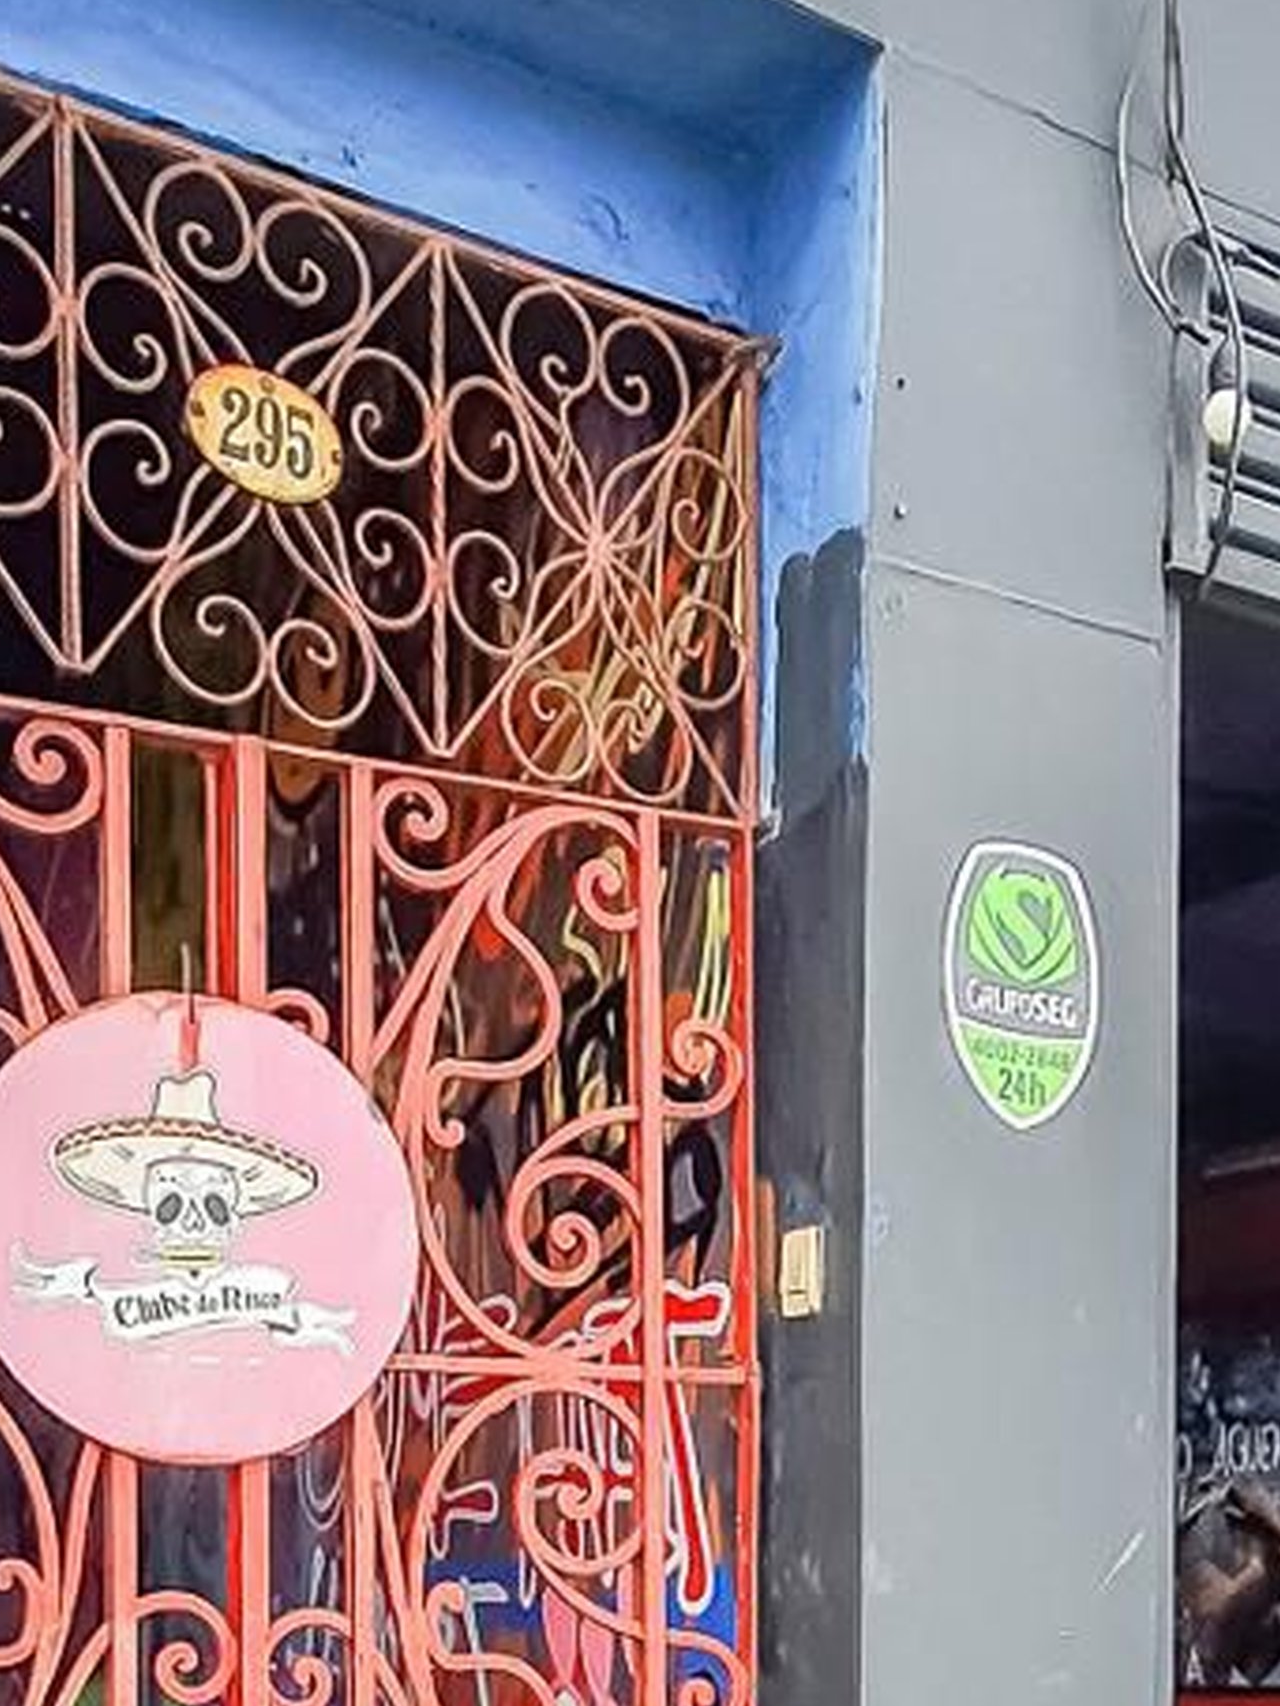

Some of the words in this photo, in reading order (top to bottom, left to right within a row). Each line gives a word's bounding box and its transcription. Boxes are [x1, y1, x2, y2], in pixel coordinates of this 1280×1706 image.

[219, 385, 314, 480] 295
[965, 978, 1077, 1029] GRUPOSEG
[998, 1067, 1047, 1107] 24h
[113, 1292, 191, 1329] Clube
[221, 1285, 283, 1312] Risco
